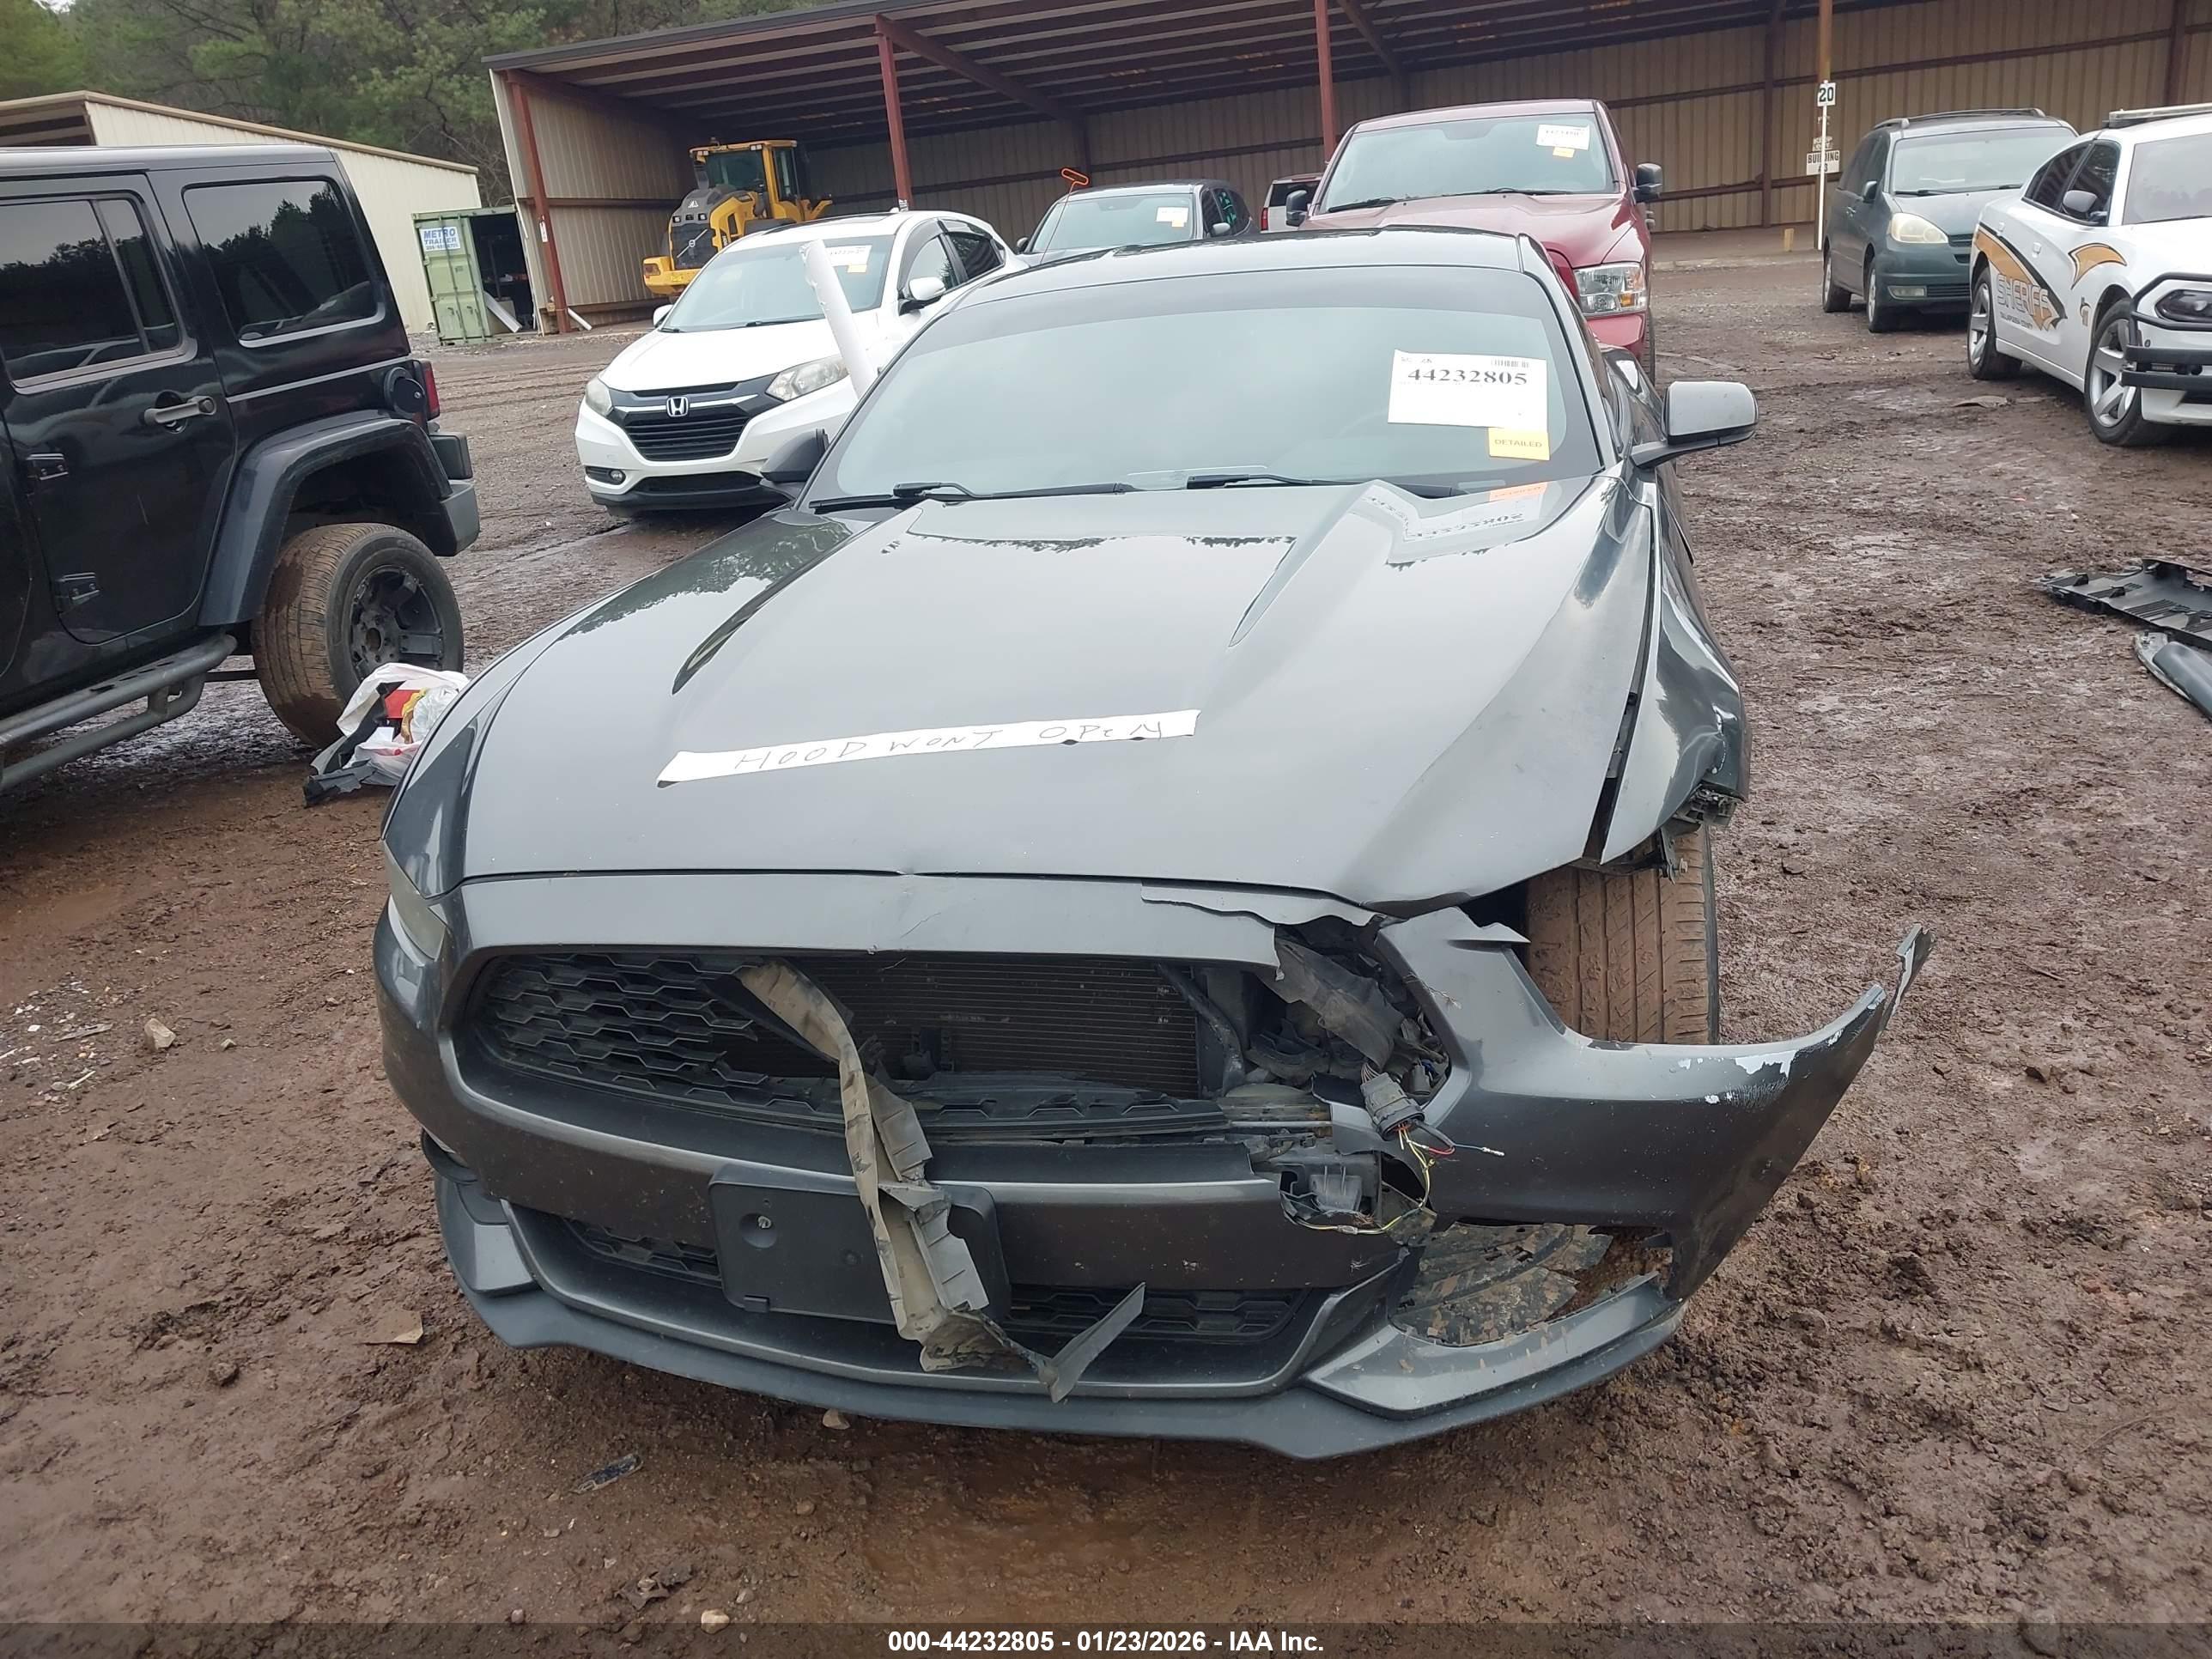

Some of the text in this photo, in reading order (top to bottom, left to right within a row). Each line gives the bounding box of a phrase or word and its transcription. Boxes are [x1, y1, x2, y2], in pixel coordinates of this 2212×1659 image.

[1819, 87, 1834, 102] 20
[423, 228, 456, 240] METRO
[1997, 274, 2048, 319] SHERIFF
[1407, 368, 1528, 385] 44232805
[1494, 439, 1543, 447] DETAILED
[734, 740, 867, 770] HOOD
[889, 728, 1004, 751] WONT
